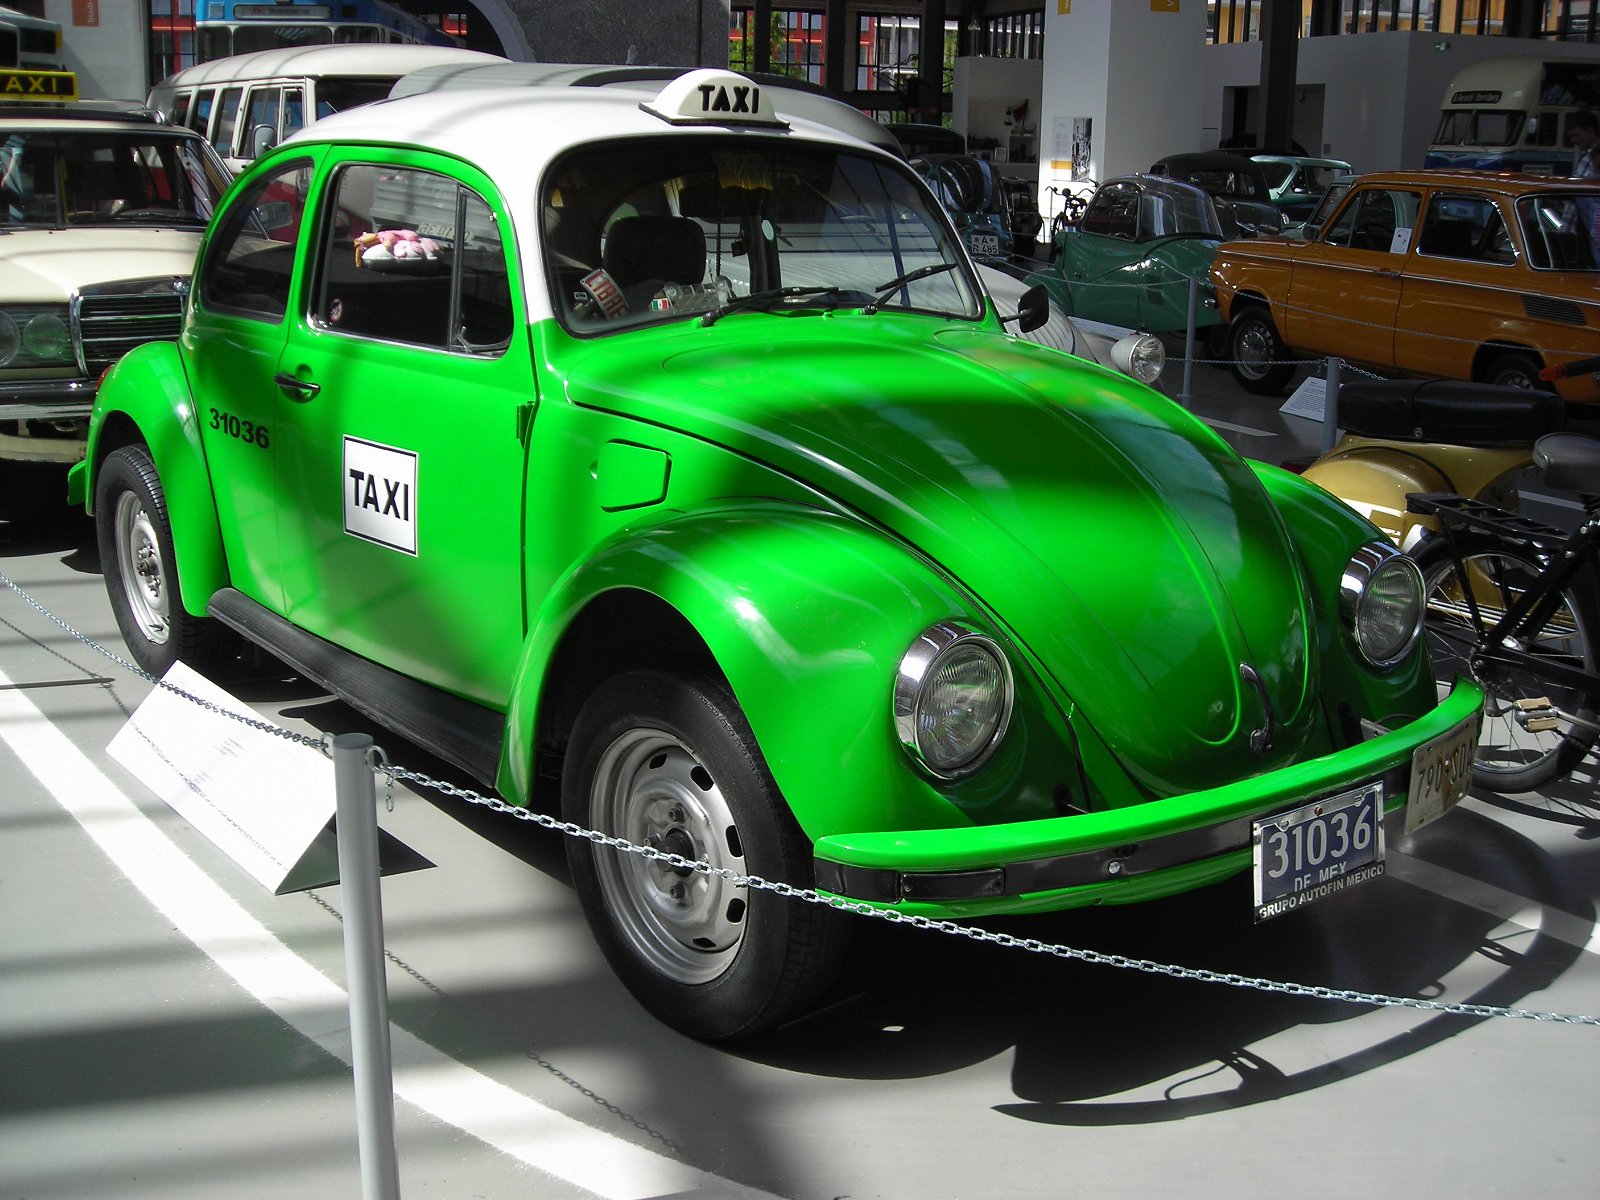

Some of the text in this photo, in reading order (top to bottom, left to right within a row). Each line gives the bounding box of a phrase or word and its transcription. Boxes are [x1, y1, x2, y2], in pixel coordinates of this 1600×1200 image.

[5, 75, 57, 93] AXI
[697, 84, 760, 114] TAXI
[585, 270, 629, 319] LIBRE
[208, 407, 270, 450] 31036
[349, 468, 410, 522] TAXI
[1268, 804, 1372, 879] 31036
[1259, 896, 1297, 919] GRUPO
[1299, 879, 1344, 905] AUTOFIN
